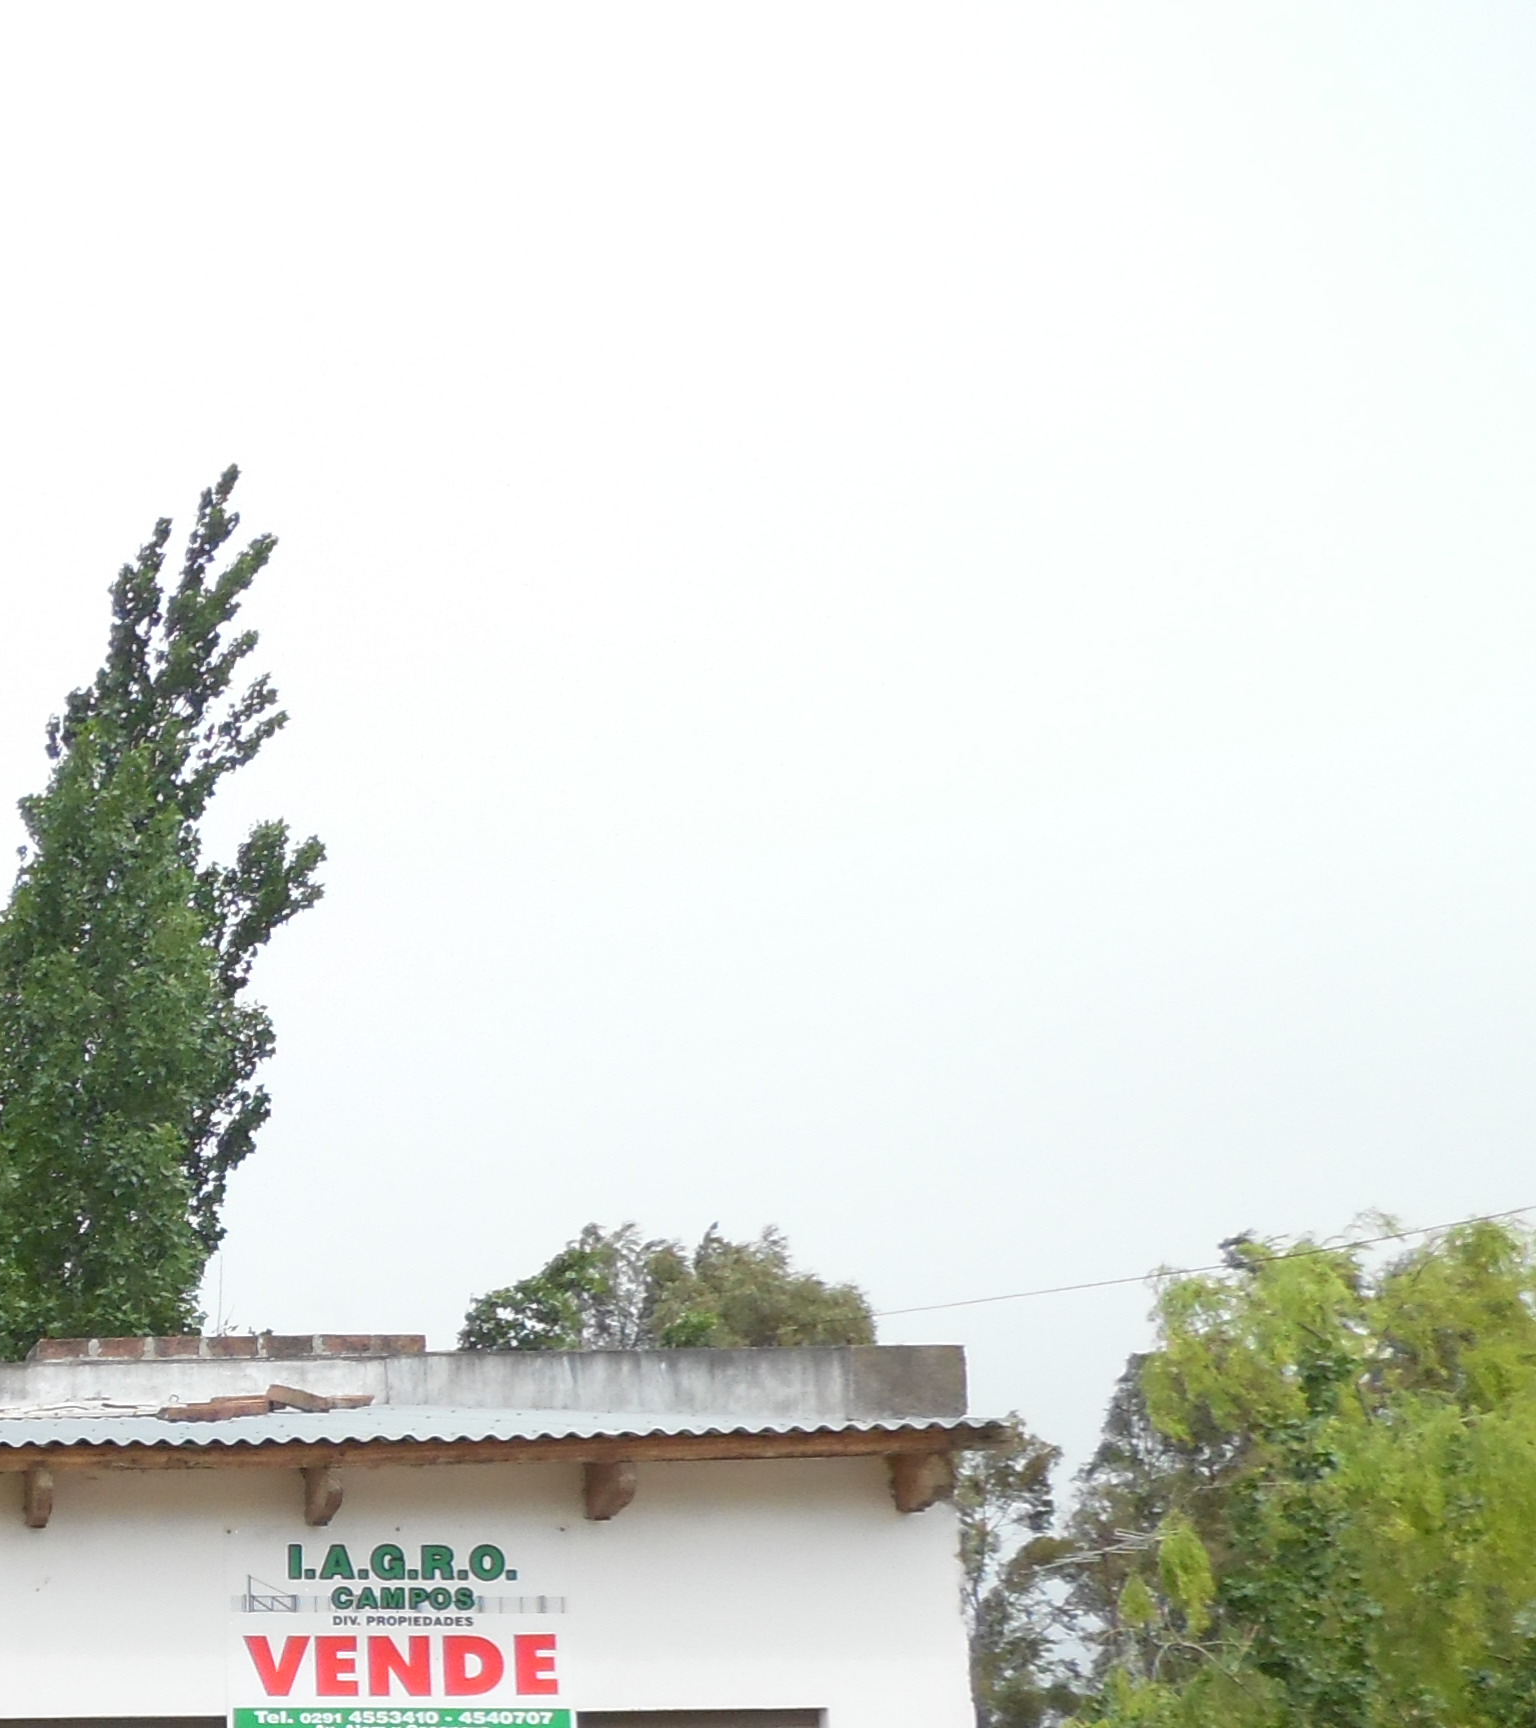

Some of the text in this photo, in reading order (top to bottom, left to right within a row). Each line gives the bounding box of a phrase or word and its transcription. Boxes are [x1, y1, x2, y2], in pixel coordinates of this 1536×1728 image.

[288, 1544, 518, 1581] I.A.G.R.O.
[331, 1586, 475, 1611] CAMPOS
[332, 1615, 474, 1627] DIV. PROPIEDADES
[243, 1633, 559, 1697] VENDE
[254, 1711, 294, 1724] Tel.
[299, 1713, 342, 1724] 0291
[348, 1711, 439, 1724] 4553410
[458, 1711, 553, 1724] 4540707
